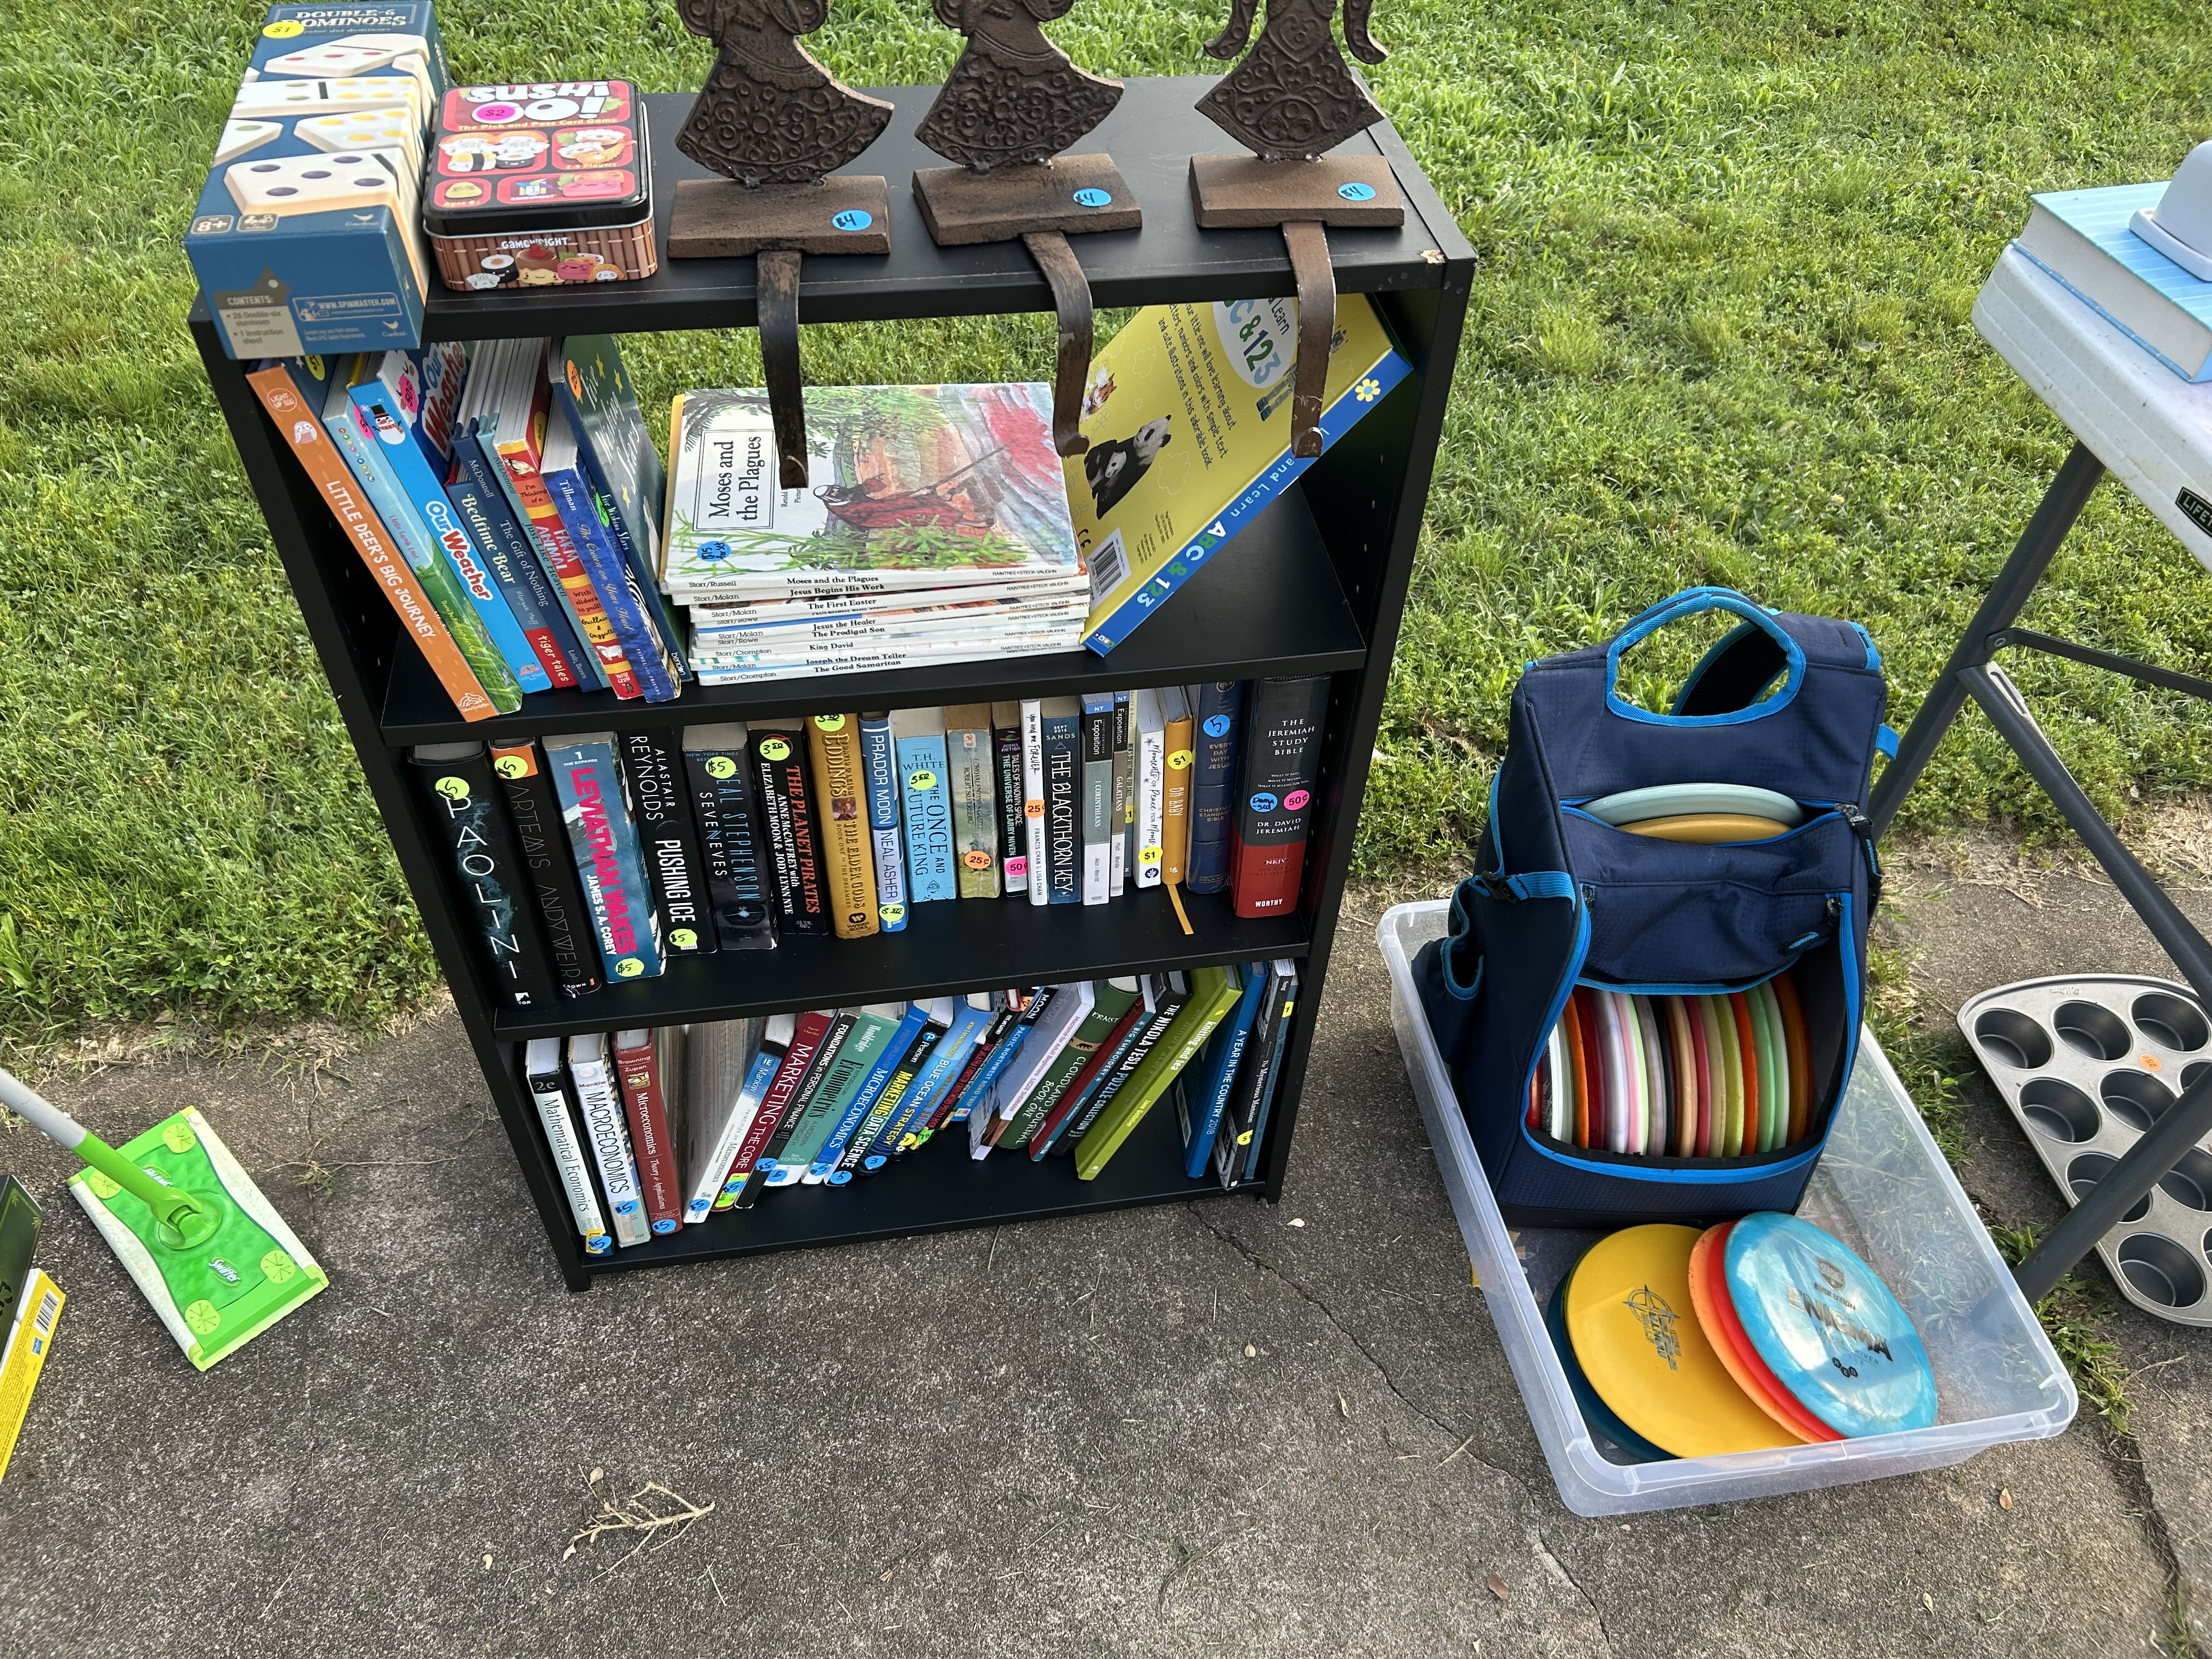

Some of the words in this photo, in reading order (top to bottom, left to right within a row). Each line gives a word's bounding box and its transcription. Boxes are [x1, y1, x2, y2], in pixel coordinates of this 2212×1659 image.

[295, 9, 396, 18] DOUBLE-6
[485, 108, 505, 117] $2
[227, 295, 273, 305] CONTENTS:
[1177, 328, 1192, 358] numbers
[1188, 358, 1198, 373] and
[1193, 373, 1204, 395] colors
[1200, 393, 1210, 413] with
[1207, 412, 1219, 437] simple
[1216, 436, 1229, 459] text
[713, 441, 733, 467] and
[738, 436, 765, 492] Plagues
[1269, 456, 1296, 480] and
[521, 489, 548, 497] Thinking
[559, 479, 577, 511] Tillman
[708, 472, 732, 518] Moses
[1229, 483, 1270, 518] Learn
[736, 495, 758, 521] the
[428, 501, 453, 533] Our
[442, 530, 492, 600] Weather
[461, 494, 498, 551] Bedtime
[493, 552, 515, 584] Bear
[535, 526, 567, 571] ANIMAL
[554, 528, 579, 562] FARM
[1186, 520, 1226, 562] ABC
[353, 523, 388, 563] DEER'S
[379, 561, 403, 588] BIG
[394, 588, 436, 639] JOURNEY
[1166, 562, 1187, 577] &
[693, 593, 740, 602] Storr/Molan
[789, 588, 812, 596] Jesus
[814, 585, 843, 594] Begins
[849, 598, 877, 606] Easter
[1136, 577, 1171, 607] 123
[712, 608, 757, 617] Storr/Molan
[718, 630, 764, 639] Storr/Molan
[830, 627, 867, 637] Prodigal
[538, 635, 556, 659] tiger
[551, 659, 569, 682] tales
[672, 652, 686, 675] bendon
[715, 648, 772, 656] Storr/Crompton
[856, 661, 901, 669] Samaritan
[720, 672, 776, 681] Storr/Crompton
[1093, 719, 1102, 755] Exposition
[1267, 726, 1314, 737] JEREMIAH
[1273, 737, 1308, 746] STUDY
[871, 735, 888, 785] PRADOR
[903, 761, 945, 770] WHITE
[1051, 751, 1071, 779] THE
[629, 735, 665, 821] REYNOLDS
[655, 749, 675, 807] ALASTAIR
[786, 765, 804, 797] THE
[876, 788, 891, 825] MOON
[699, 791, 727, 877] SEVENEVES
[791, 799, 812, 854] PLANET
[1052, 783, 1073, 866] BLACKTHORN
[1256, 825, 1300, 835] JEREMIAH
[722, 812, 761, 900] STEPHENSON
[881, 832, 894, 860] NEAL
[1145, 851, 1155, 860] $1
[570, 767, 622, 887] LEVIATHAN
[603, 888, 637, 956] WAKES
[655, 839, 692, 899] PUSHING
[970, 856, 989, 865] 25¢
[445, 795, 520, 979] PAOLINI
[800, 854, 820, 913] PIRATES
[883, 865, 898, 899] ASHER
[1054, 869, 1073, 891] KEY
[668, 902, 696, 923] ICE
[1255, 899, 1283, 907] WORTHY
[1092, 1012, 1119, 1023] ERNST
[1167, 1004, 1180, 1017] THE
[1138, 1015, 1169, 1046] NIKOLA
[1187, 1020, 1216, 1047] knitting
[818, 1023, 849, 1067] FOUNDATIONS
[911, 1041, 930, 1063] Pearson
[1120, 1048, 1149, 1070] TESLA
[1180, 1047, 1194, 1059] and
[1232, 1037, 1245, 1059] YEAR
[618, 1055, 651, 1065] Browning
[816, 1065, 822, 1073] in
[929, 1059, 951, 1080] BLUE
[1170, 1059, 1185, 1070] tea
[758, 1042, 813, 1125] MARKETING
[799, 1072, 822, 1106] PERSONAL
[808, 1058, 866, 1119] Econometrics
[1045, 1056, 1086, 1108] CLOUDLAND
[1106, 1072, 1129, 1099] PUZZLE
[1223, 1068, 1235, 1082] THE
[874, 1070, 913, 1117] MARKETING
[910, 1080, 934, 1108] OCEAN
[1036, 1080, 1054, 1102] BOOK
[1212, 1083, 1230, 1118] COUNTRY
[785, 1104, 804, 1129] FINANCE
[830, 1067, 889, 1149] MICROECONOMICS
[1023, 1103, 1037, 1119] ONE
[1076, 1097, 1106, 1131] COLLECTION
[636, 1092, 657, 1155] Microeconomics
[747, 1126, 766, 1149] THE
[862, 1116, 884, 1138] DATA
[883, 1108, 915, 1146] STRATEGY
[1015, 1106, 1048, 1144] JOURNAL
[1206, 1119, 1219, 1135] 2018
[544, 1098, 578, 1163] Mathematical
[566, 1164, 590, 1212] Economics
[585, 1091, 630, 1194] MACROECONOMICS
[840, 1135, 871, 1168] SCIENCE
[736, 1147, 755, 1169] CORE
[208, 1259, 241, 1282] Swiffer
[1814, 1283, 1855, 1311] EVOLUTION
[1787, 1285, 1893, 1361] ENIGMA
